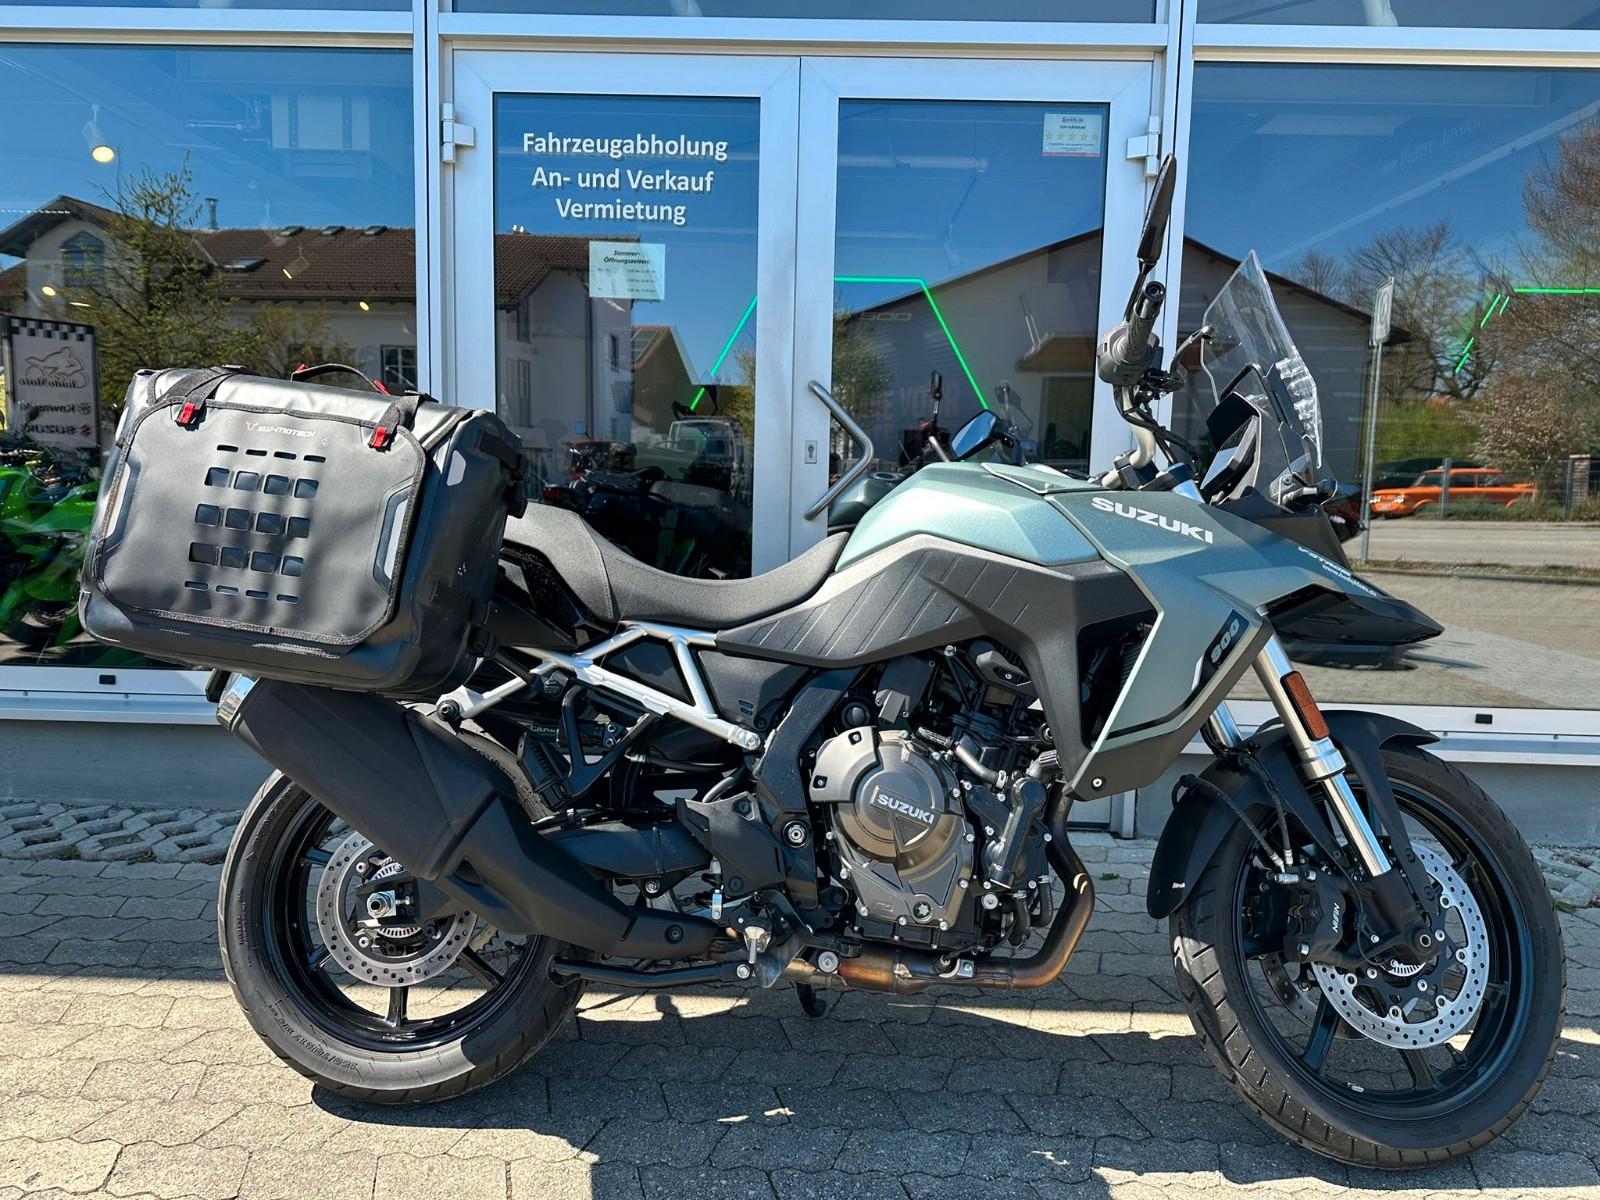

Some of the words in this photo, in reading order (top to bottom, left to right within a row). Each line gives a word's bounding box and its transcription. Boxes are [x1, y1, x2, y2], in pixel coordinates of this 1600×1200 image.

[523, 132, 728, 161] Fahrzeugabholung
[531, 166, 571, 187] An-
[577, 168, 620, 189] und
[626, 169, 715, 192] Verkauf
[555, 198, 686, 226] Vermietung
[1091, 496, 1214, 545] SUZUKI
[1210, 618, 1240, 664] 800
[876, 793, 935, 825] SUZUKI
